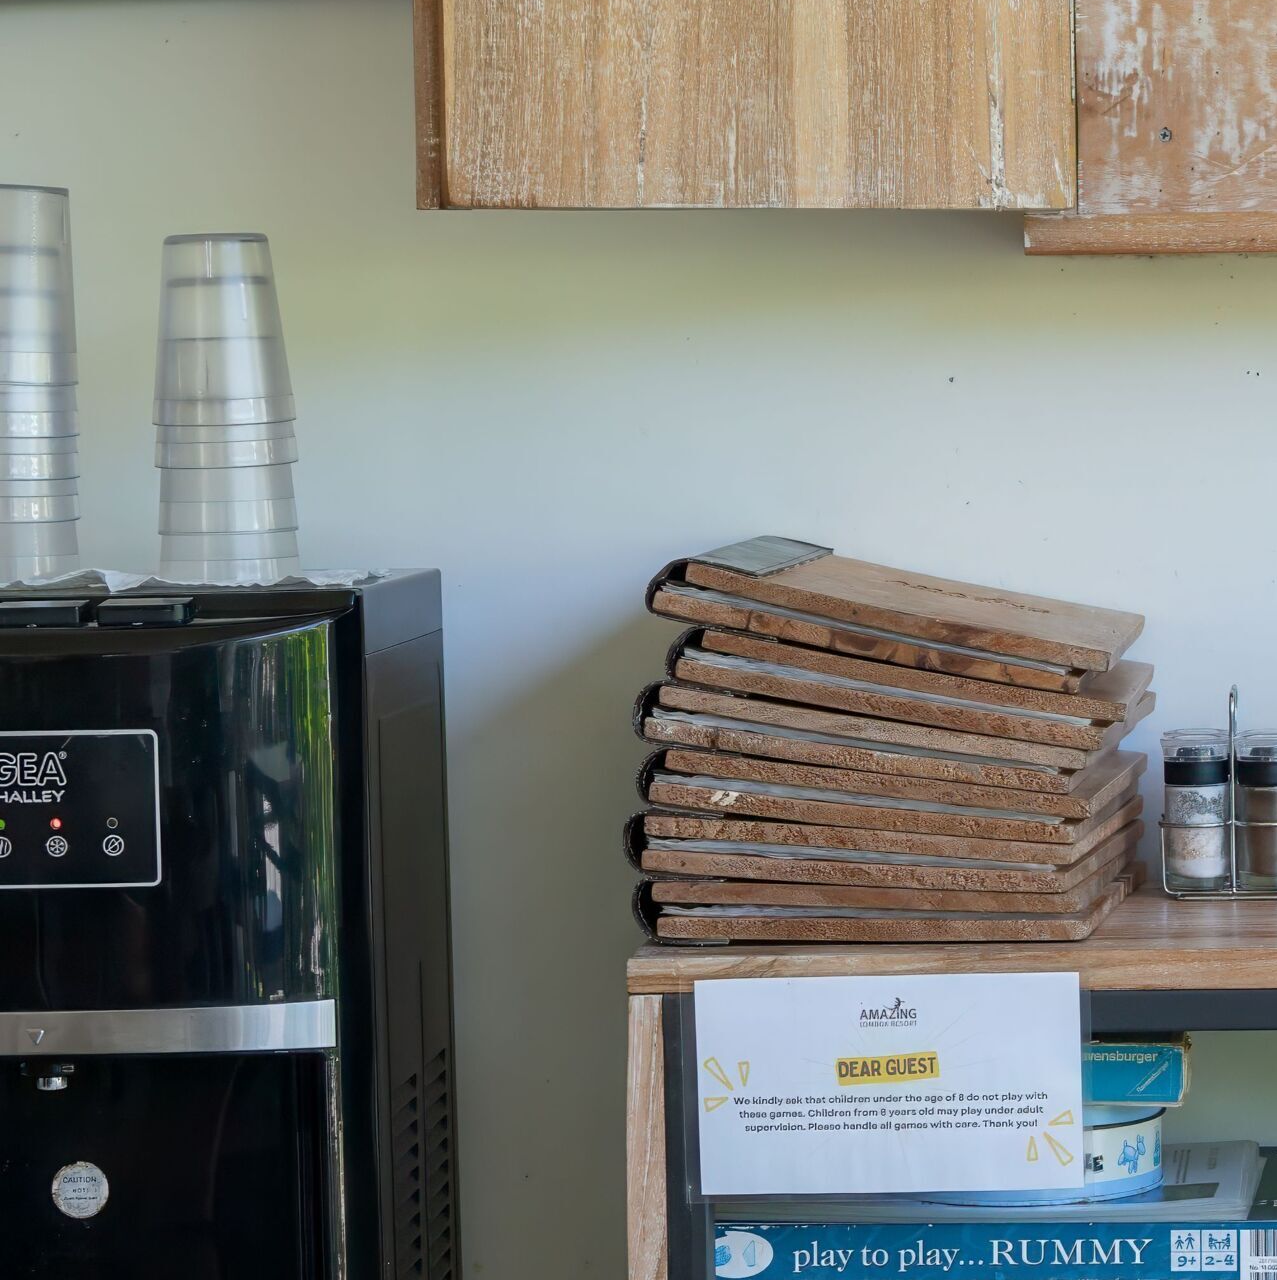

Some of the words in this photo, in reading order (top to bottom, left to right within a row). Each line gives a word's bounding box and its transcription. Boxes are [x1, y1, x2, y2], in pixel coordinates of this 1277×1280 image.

[859, 1006, 917, 1021] AMAZING
[838, 1059, 881, 1078] DEAR
[886, 1056, 937, 1076] GUEST
[752, 1095, 784, 1107] kindly
[805, 1095, 827, 1105] that
[828, 1093, 871, 1104] children
[982, 1092, 1000, 1102] not
[1001, 1091, 1024, 1103] play
[1025, 1090, 1048, 1101] with
[807, 1108, 851, 1118] Children
[853, 1108, 878, 1118] from
[918, 1106, 935, 1116] old
[936, 1106, 959, 1118] may
[1016, 1105, 1044, 1115] adult
[929, 1120, 953, 1130] with
[793, 1240, 854, 1273] play
[860, 1246, 889, 1267] to
[898, 1239, 984, 1273] play...
[989, 1239, 1153, 1266] RUMMY
[1176, 1254, 1198, 1268] 9+
[1204, 1254, 1236, 1267] 2-4
